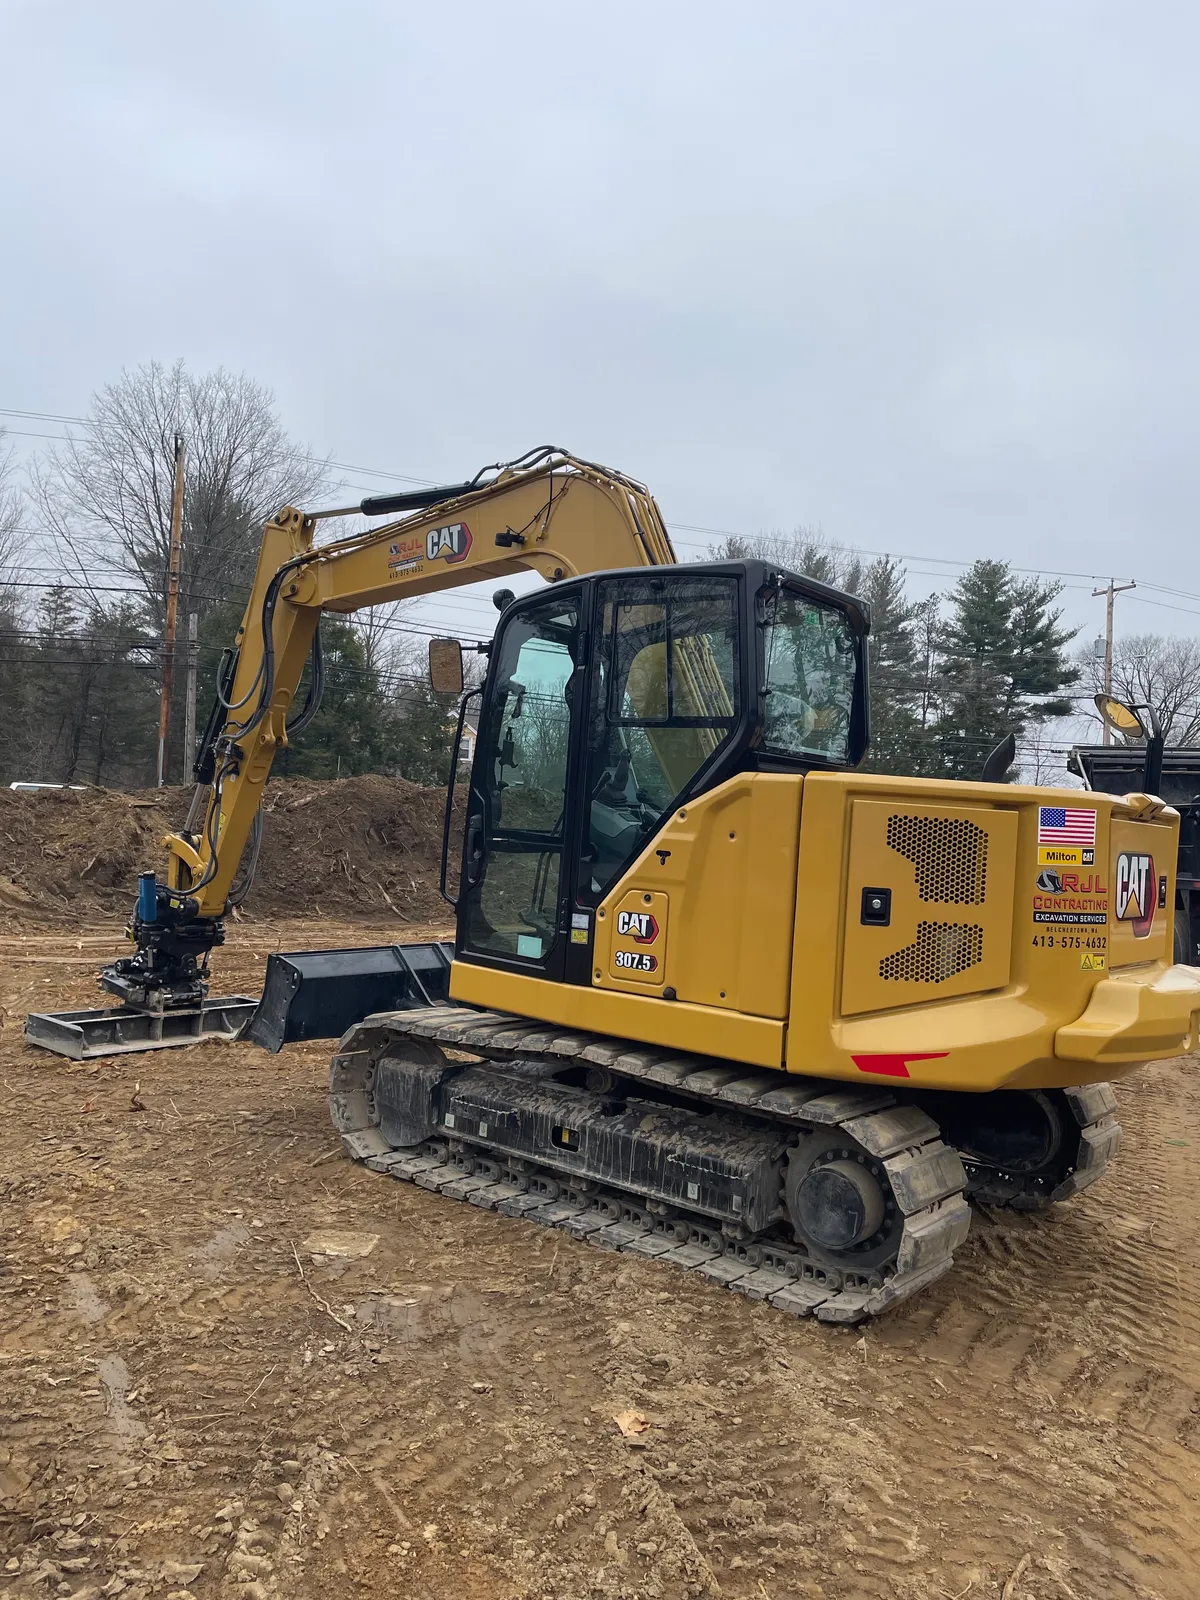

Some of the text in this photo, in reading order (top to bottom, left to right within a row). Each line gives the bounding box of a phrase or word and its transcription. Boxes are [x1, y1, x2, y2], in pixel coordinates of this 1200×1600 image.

[399, 538, 423, 552] RJL
[427, 524, 461, 560] CAT
[1046, 851, 1094, 861] Milton CAT
[1061, 873, 1107, 893] RJL
[1116, 854, 1149, 919] CAT
[1033, 895, 1108, 911] CONTRACTING
[618, 911, 650, 937] CAT
[1035, 913, 1106, 923] EXCAVATION SERVICES
[1032, 935, 1107, 949] 413-575-4632
[615, 951, 651, 971] 307.5
